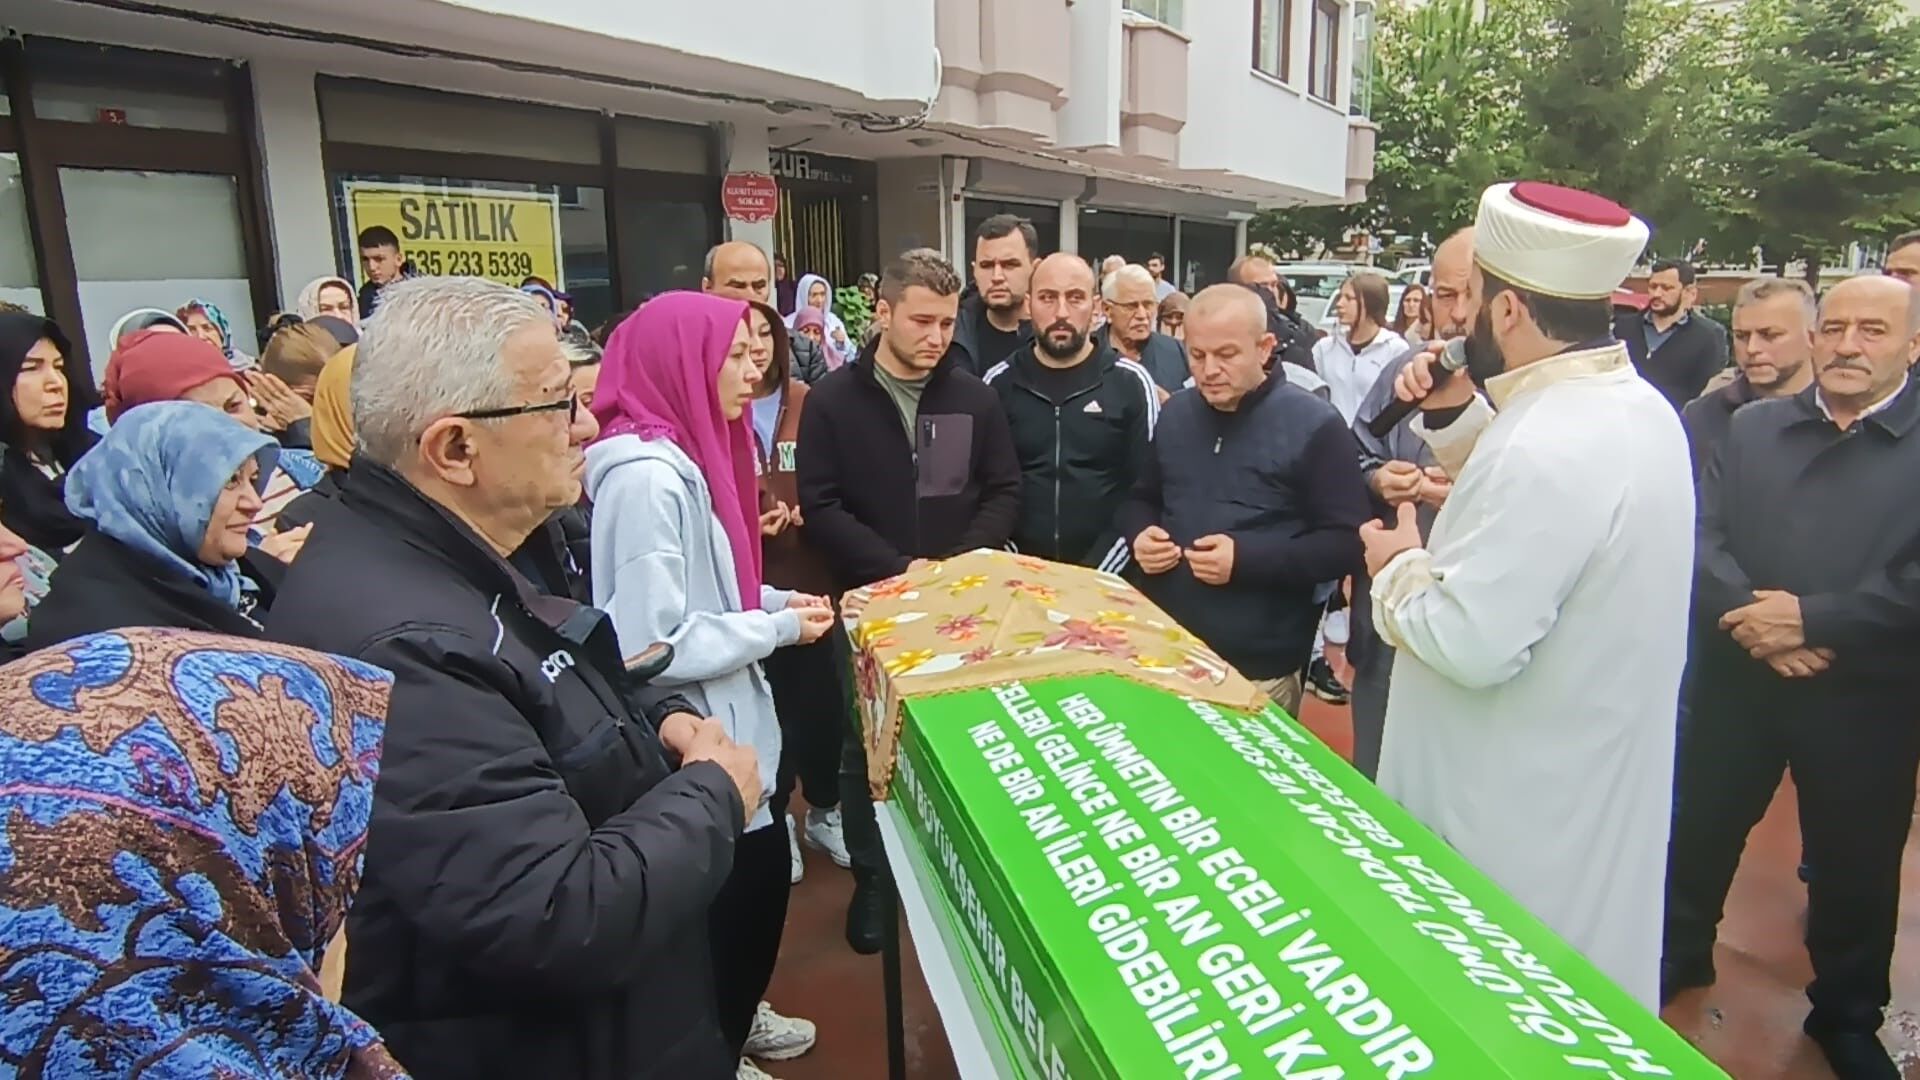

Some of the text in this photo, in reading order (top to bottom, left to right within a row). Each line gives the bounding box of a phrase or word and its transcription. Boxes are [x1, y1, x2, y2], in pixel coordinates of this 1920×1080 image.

[400, 198, 518, 242] SATILIK
[737, 197, 765, 206] SOKAK
[448, 250, 484, 277] 233
[489, 252, 532, 277] 5339
[967, 719, 1007, 749] NE
[982, 741, 1025, 773] DE
[998, 767, 1046, 806] BİR
[1035, 733, 1119, 816] GELİNCE
[1257, 769, 1308, 795] VE
[1020, 803, 1071, 841] AN
[1093, 809, 1147, 851] NE
[1043, 831, 1125, 907] İLERİ
[1119, 844, 1181, 898] BİR
[1290, 799, 1436, 914] TADACAK
[1056, 692, 1107, 730] HER
[1160, 806, 1221, 855] BİR
[1198, 847, 1312, 937] ECELİ
[1278, 928, 1434, 1080] VARDIR
[916, 778, 1008, 993] BÜYÜKŞEHİR
[1010, 965, 1073, 1080] BELE
[1153, 894, 1224, 947] AN
[1197, 943, 1306, 1036] GERİ
[1393, 856, 1673, 1076] HUZURUMUZA
